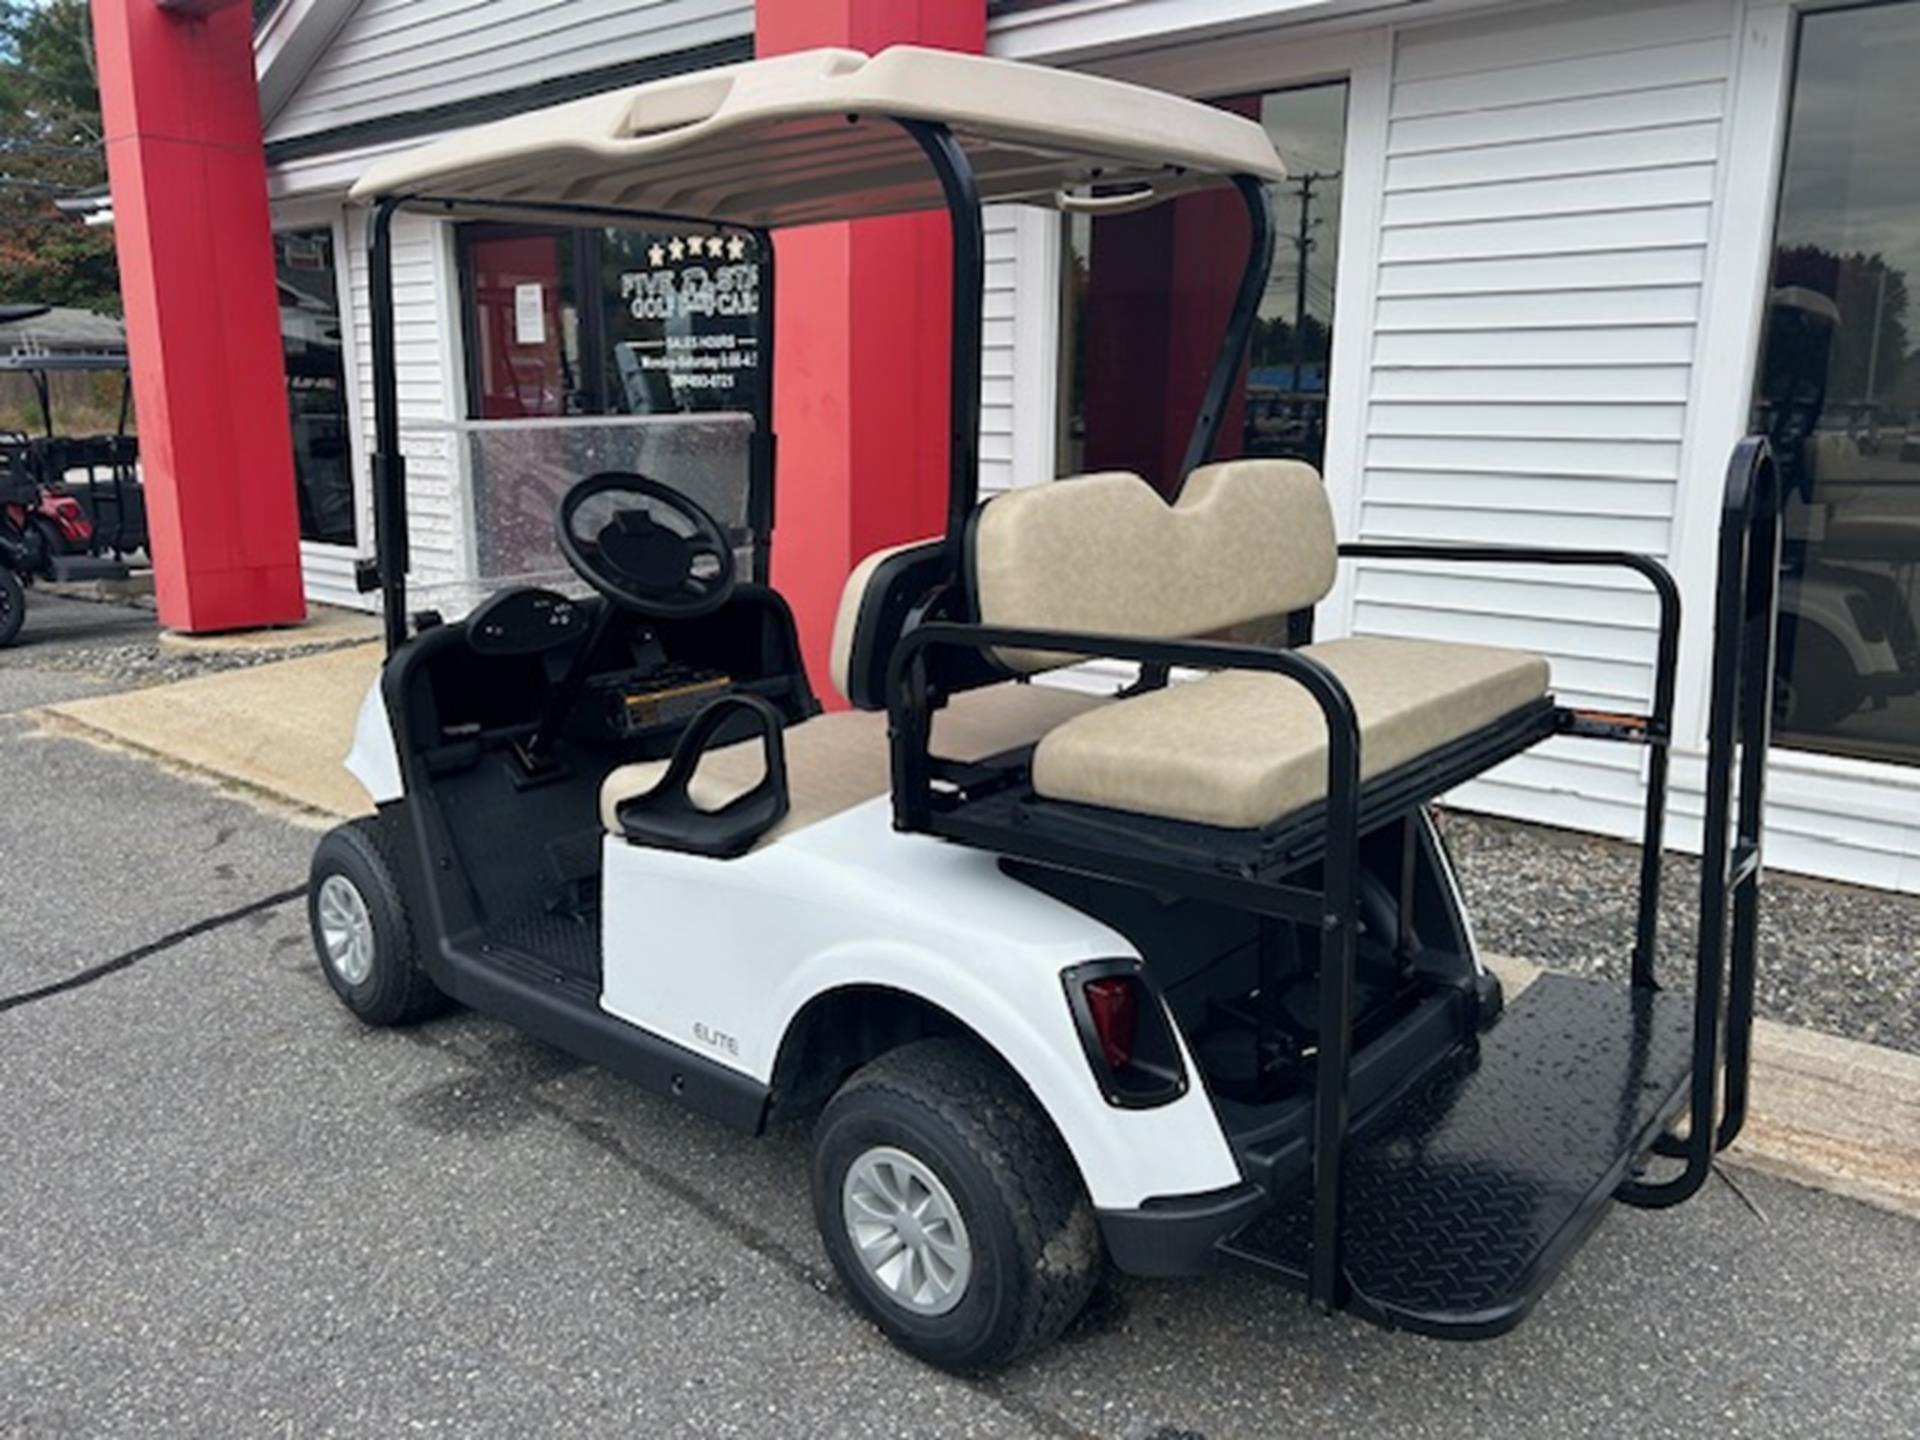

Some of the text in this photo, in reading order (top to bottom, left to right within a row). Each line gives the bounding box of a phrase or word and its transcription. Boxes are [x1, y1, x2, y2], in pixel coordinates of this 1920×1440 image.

[621, 270, 677, 298] FIVE
[631, 295, 675, 319] GOLF
[700, 334, 735, 349] HOURS
[693, 1022, 738, 1056] ELITE
